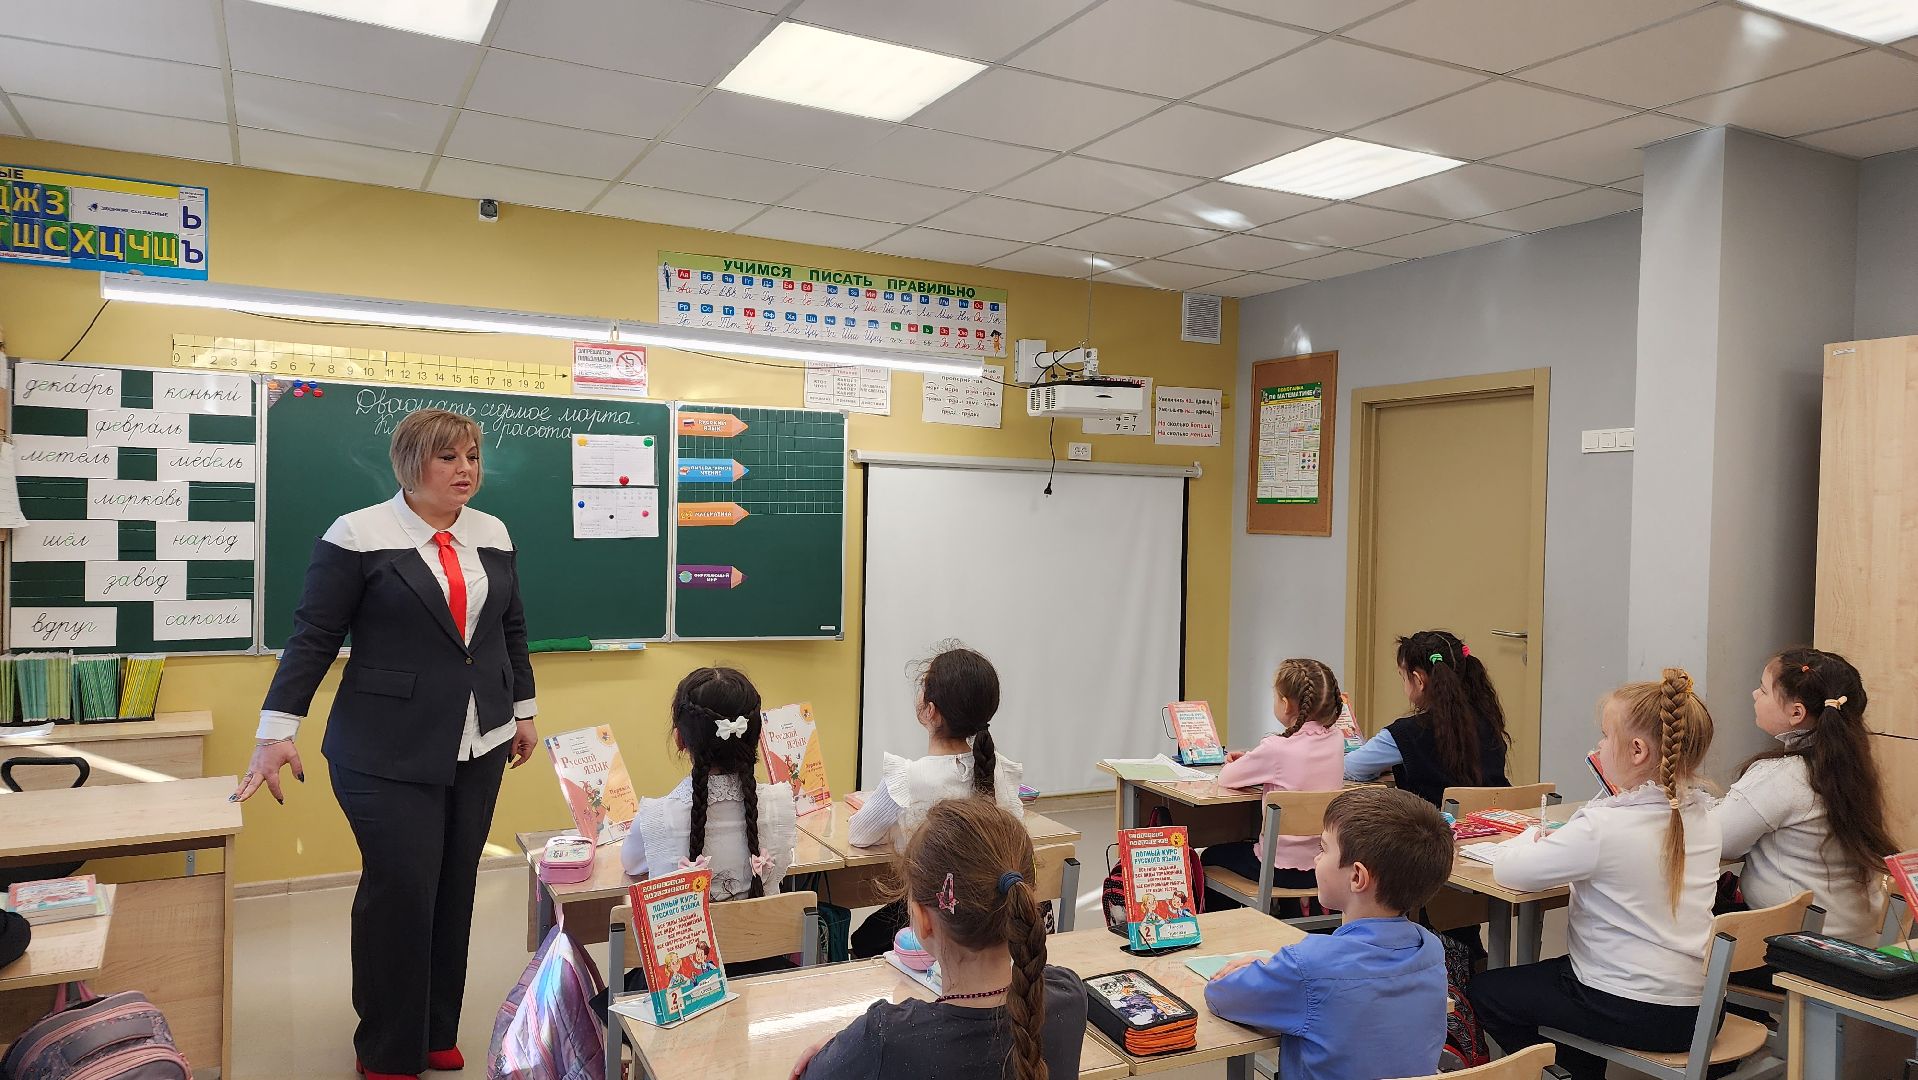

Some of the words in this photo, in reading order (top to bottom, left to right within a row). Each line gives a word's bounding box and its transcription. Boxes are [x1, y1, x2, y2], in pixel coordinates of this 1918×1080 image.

[13, 187, 40, 212] Ж
[45, 190, 65, 215] З
[13, 223, 39, 248] Ш
[45, 226, 66, 250] С
[72, 228, 96, 254] Х
[100, 231, 124, 260] Ц
[129, 234, 150, 258] Ч
[154, 236, 177, 265] Щ
[723, 259, 792, 279] УЧИМСЯ
[809, 269, 873, 287] ПИСАТЬ
[887, 278, 976, 298] ПРАВИЛЬНО
[173, 352, 180, 363] 0
[191, 354, 196, 363] 1
[210, 355, 217, 365] 2
[231, 356, 238, 366] 3
[250, 358, 257, 368] 4
[270, 360, 278, 369] 5
[290, 361, 297, 371] 6
[309, 362, 316, 372] 7
[328, 364, 335, 373] 8
[347, 365, 353, 375] 9
[363, 367, 374, 376] 10
[386, 369, 394, 378] 11
[400, 370, 410, 379] 12
[417, 371, 427, 380] 13
[435, 373, 444, 381] 14
[452, 374, 462, 383] 15
[468, 375, 479, 384] 16
[486, 376, 495, 385] 17
[503, 378, 512, 387] 18
[519, 379, 529, 388] 19
[534, 380, 545, 390] 20
[1277, 389, 1313, 399] МАТЕМАТИКЕ
[480, 402, 553, 431] седьмое
[42, 533, 90, 548] шёл
[31, 612, 97, 641] вдруг
[560, 753, 597, 769] Русский
[652, 897, 679, 913] ПОЛНЫЙ
[680, 893, 698, 904] КУРС
[652, 906, 680, 921] РУССКОГО
[680, 901, 700, 912] ЯЗЫКА
[1145, 926, 1151, 937] 2
[671, 992, 678, 1005] 2
